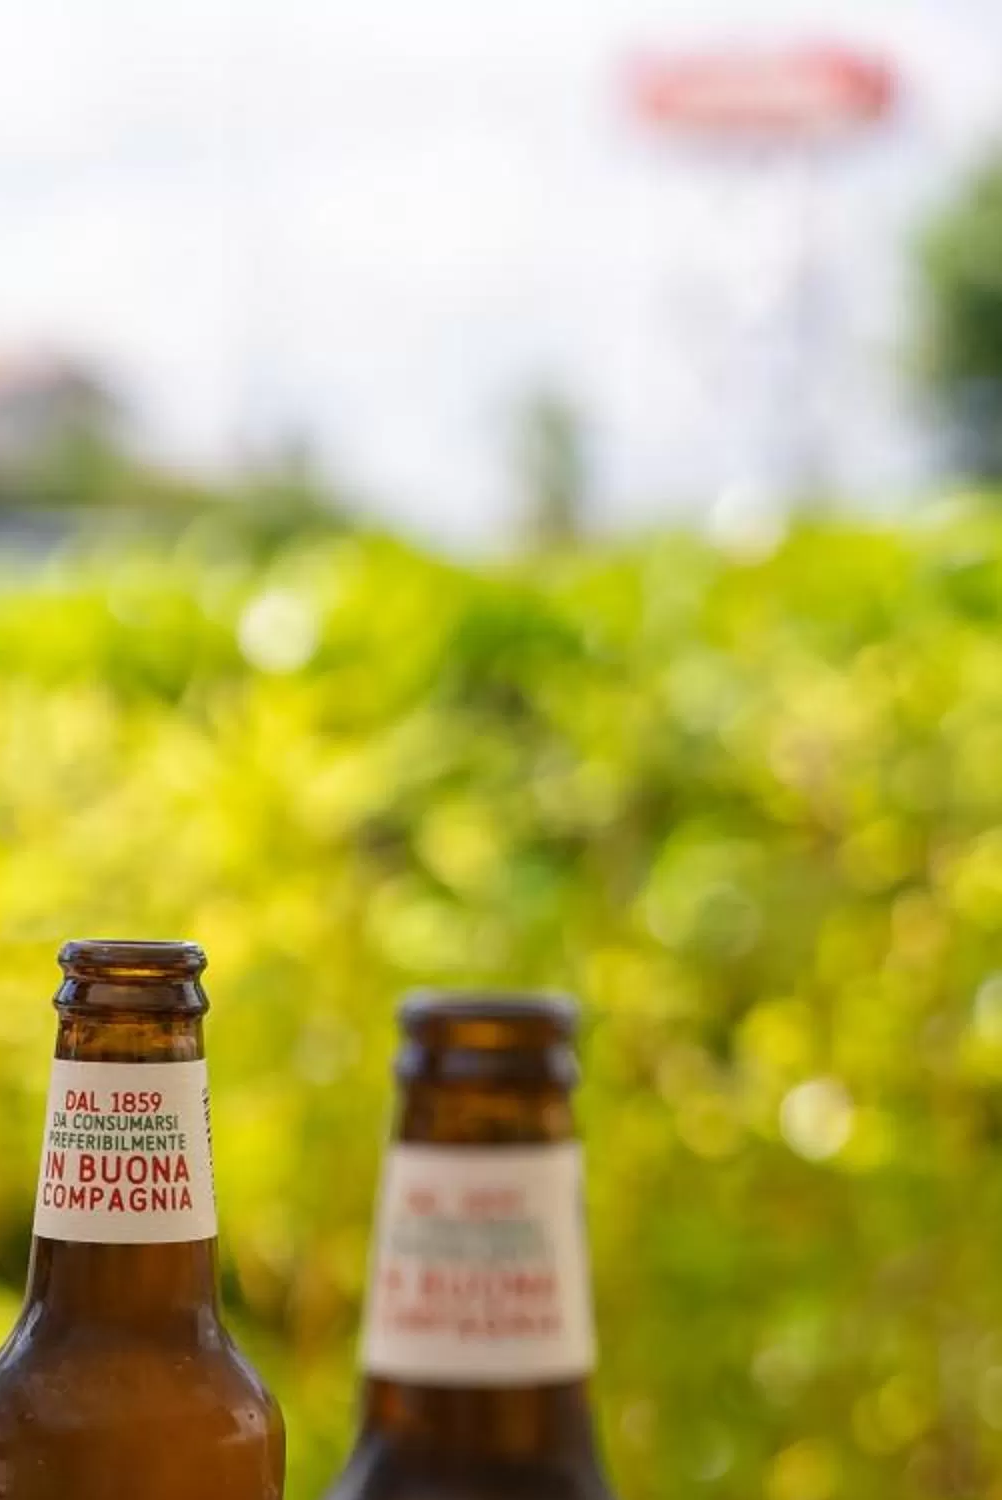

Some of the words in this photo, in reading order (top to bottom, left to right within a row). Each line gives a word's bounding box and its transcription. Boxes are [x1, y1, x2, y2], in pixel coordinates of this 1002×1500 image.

[65, 1089, 100, 1113] DAL
[111, 1091, 163, 1113] 1859
[53, 1112, 67, 1129] DA
[73, 1114, 178, 1131] CONSUMARSI
[49, 1131, 187, 1151] PREFERIBILMENTE
[45, 1151, 65, 1181] IN
[78, 1154, 190, 1184] BUONA
[42, 1183, 193, 1213] COMPAGNIA
